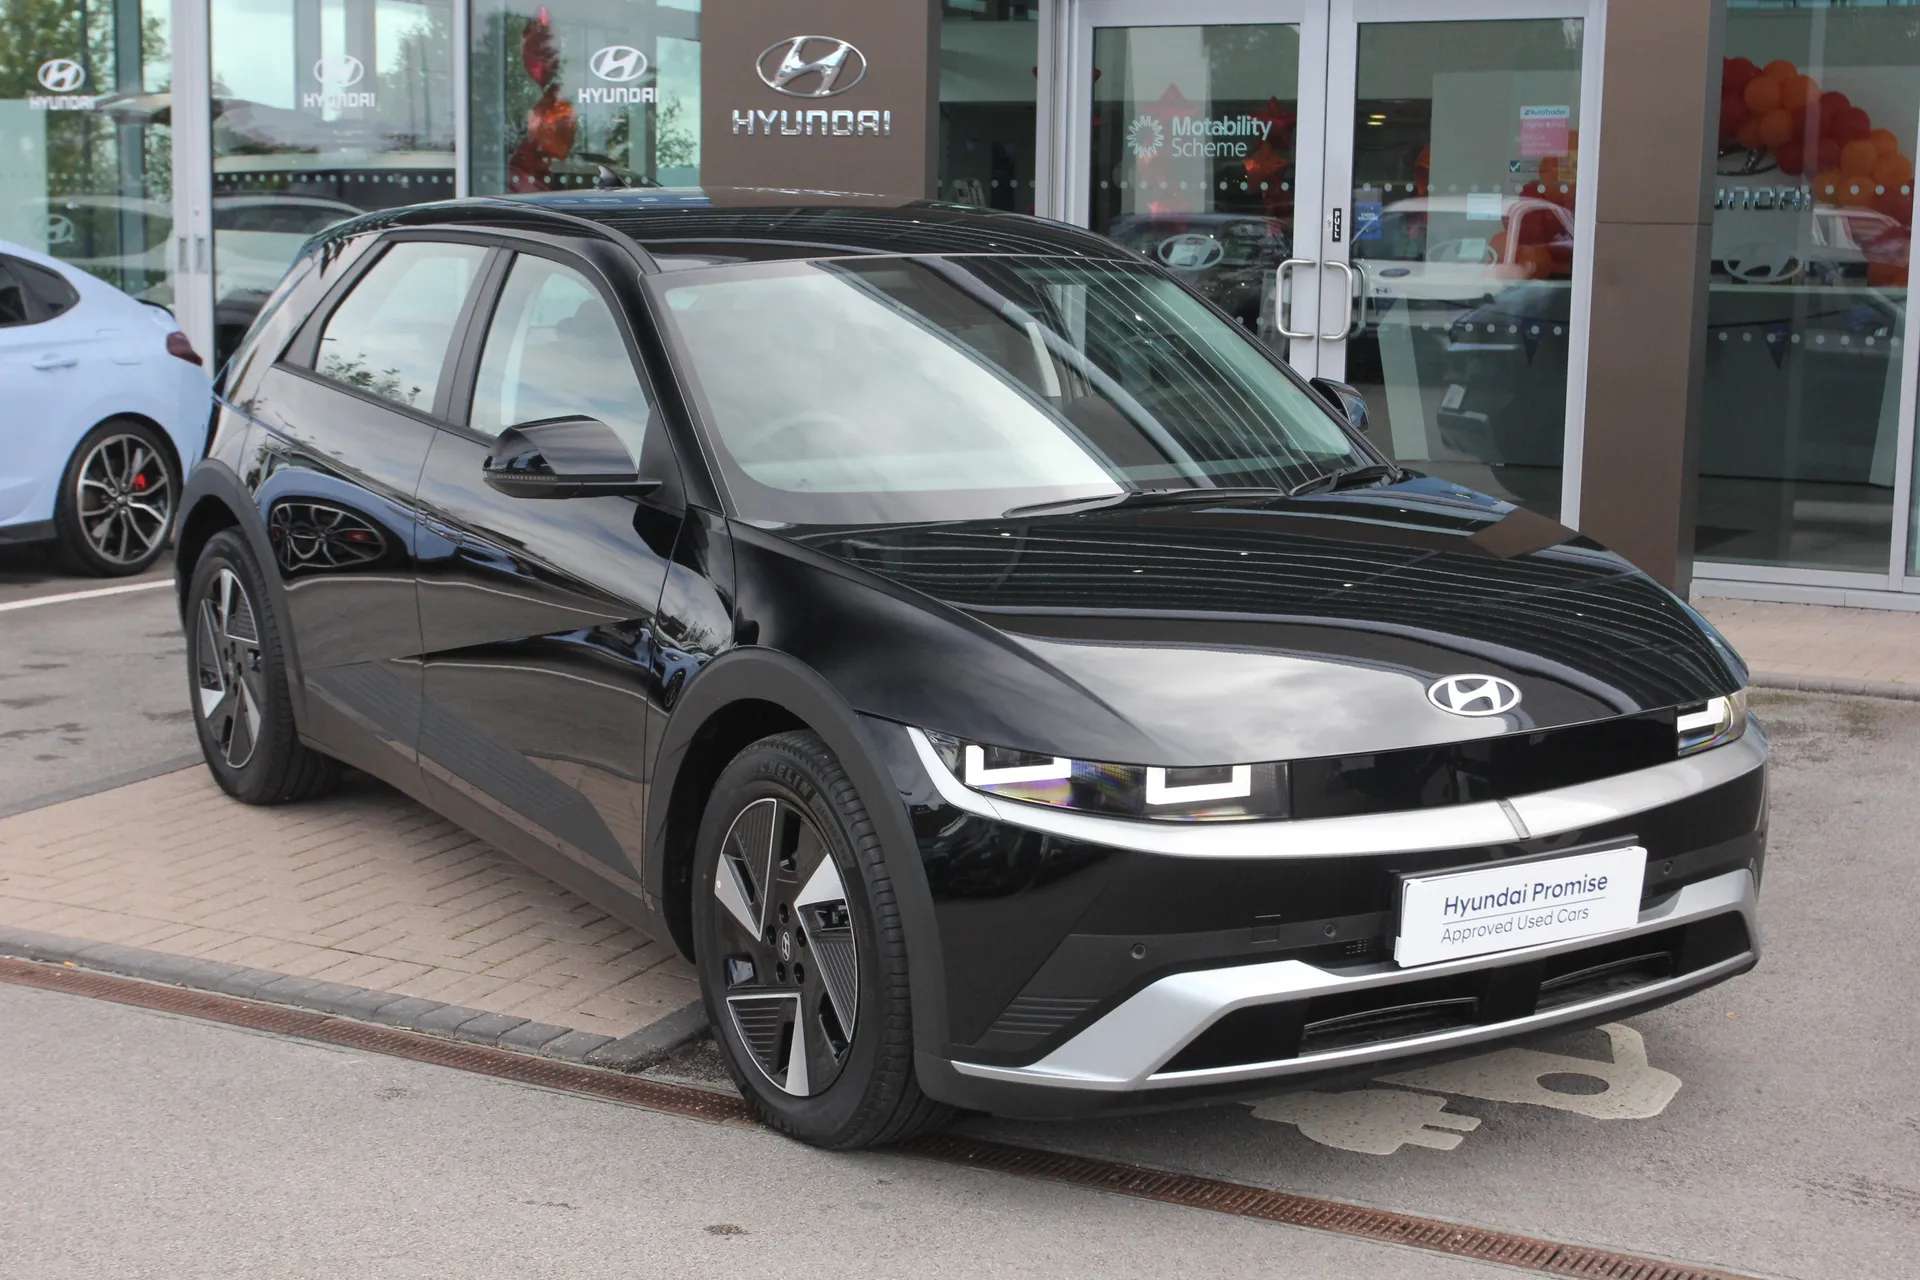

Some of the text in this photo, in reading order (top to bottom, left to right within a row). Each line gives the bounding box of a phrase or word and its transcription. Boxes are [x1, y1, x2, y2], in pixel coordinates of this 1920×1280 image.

[732, 109, 890, 136] HYUNDAI
[1172, 115, 1273, 141] Motability
[1172, 138, 1248, 158] Scheme
[1443, 874, 1609, 917] Hyundai Promise
[1441, 906, 1590, 944] Approved Used Cars
